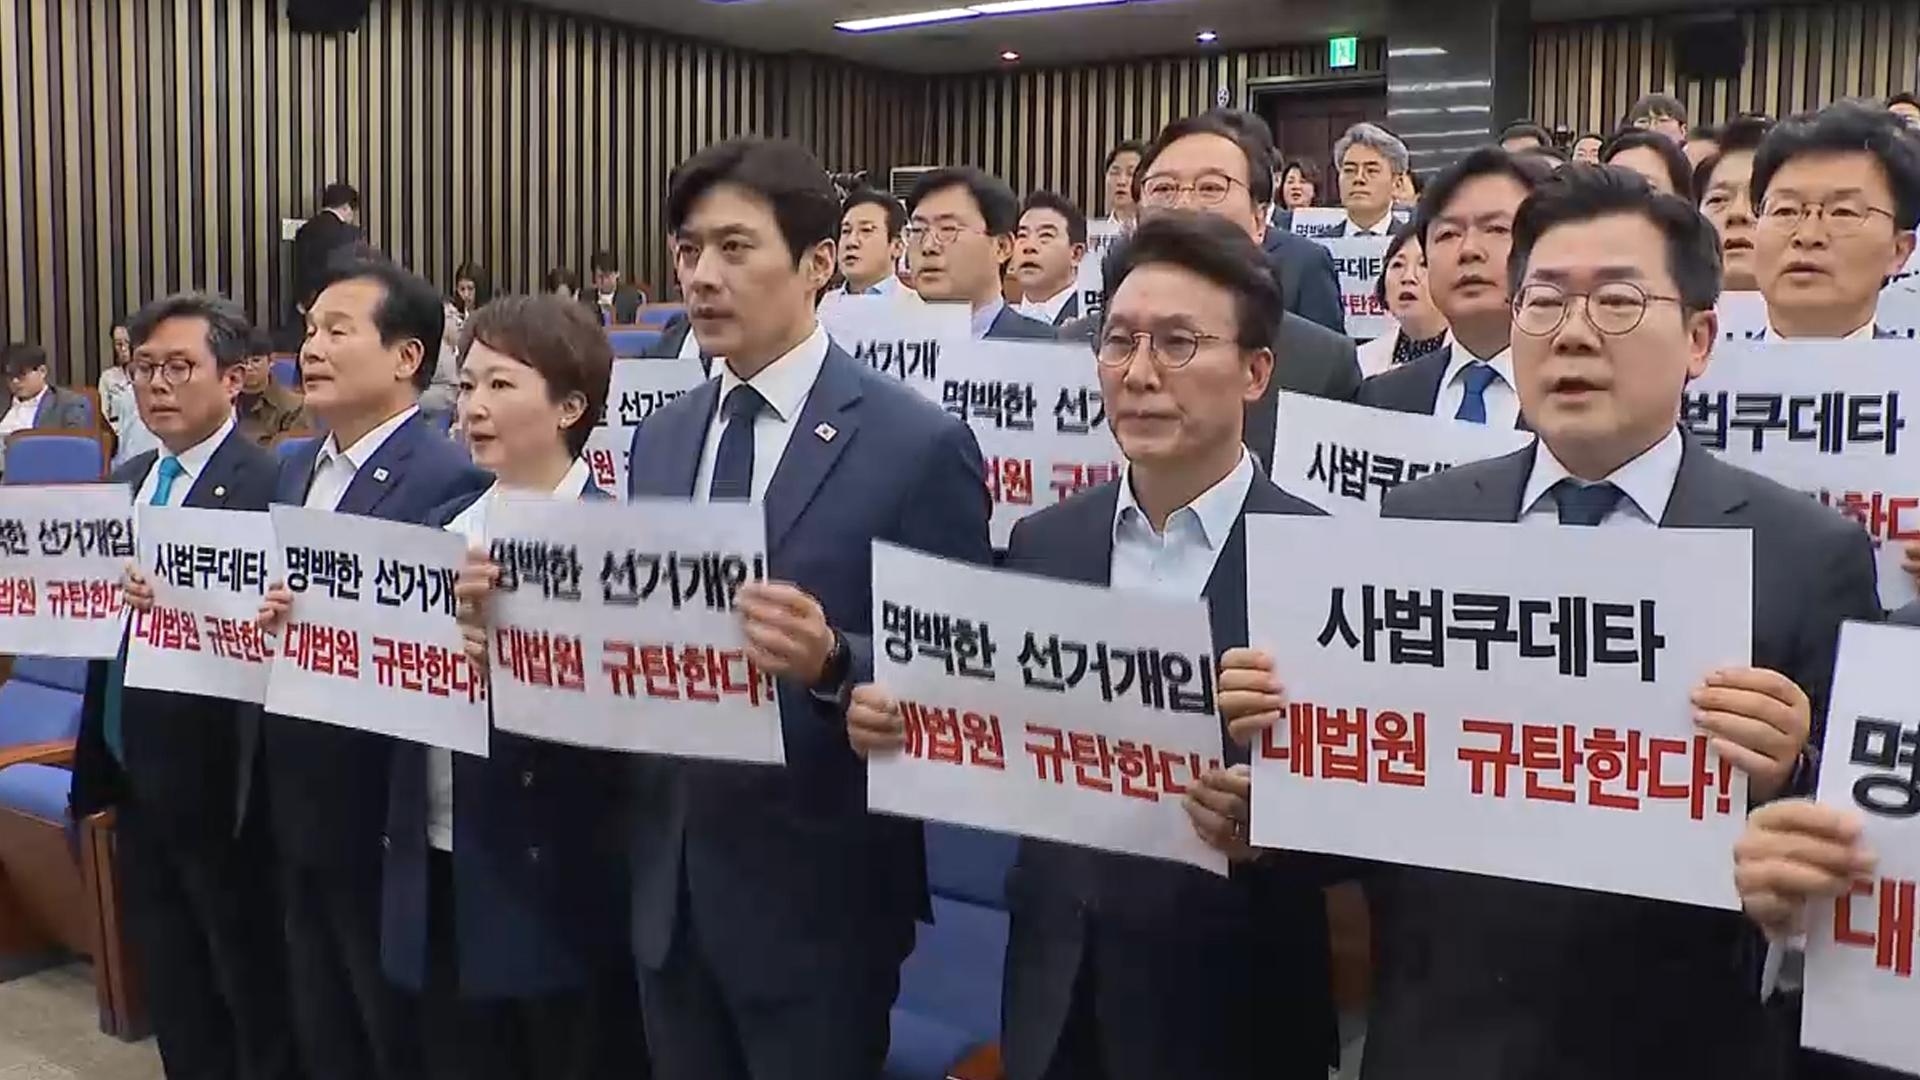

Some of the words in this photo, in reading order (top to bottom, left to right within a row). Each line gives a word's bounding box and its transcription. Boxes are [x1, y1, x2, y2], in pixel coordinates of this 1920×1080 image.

[942, 379, 1037, 430] 명백한
[39, 516, 135, 558] 선거개입
[154, 541, 268, 595] 사법쿠데타
[286, 546, 363, 602] 명백한
[284, 620, 360, 680] 대법원
[496, 625, 586, 694] 대법원
[882, 600, 997, 682] 명백한
[1016, 630, 1215, 717] 선거개입
[1316, 584, 1666, 683] 사법쿠데타
[1261, 702, 1427, 788] 대법원
[1457, 718, 1732, 821] 규탄한다!
